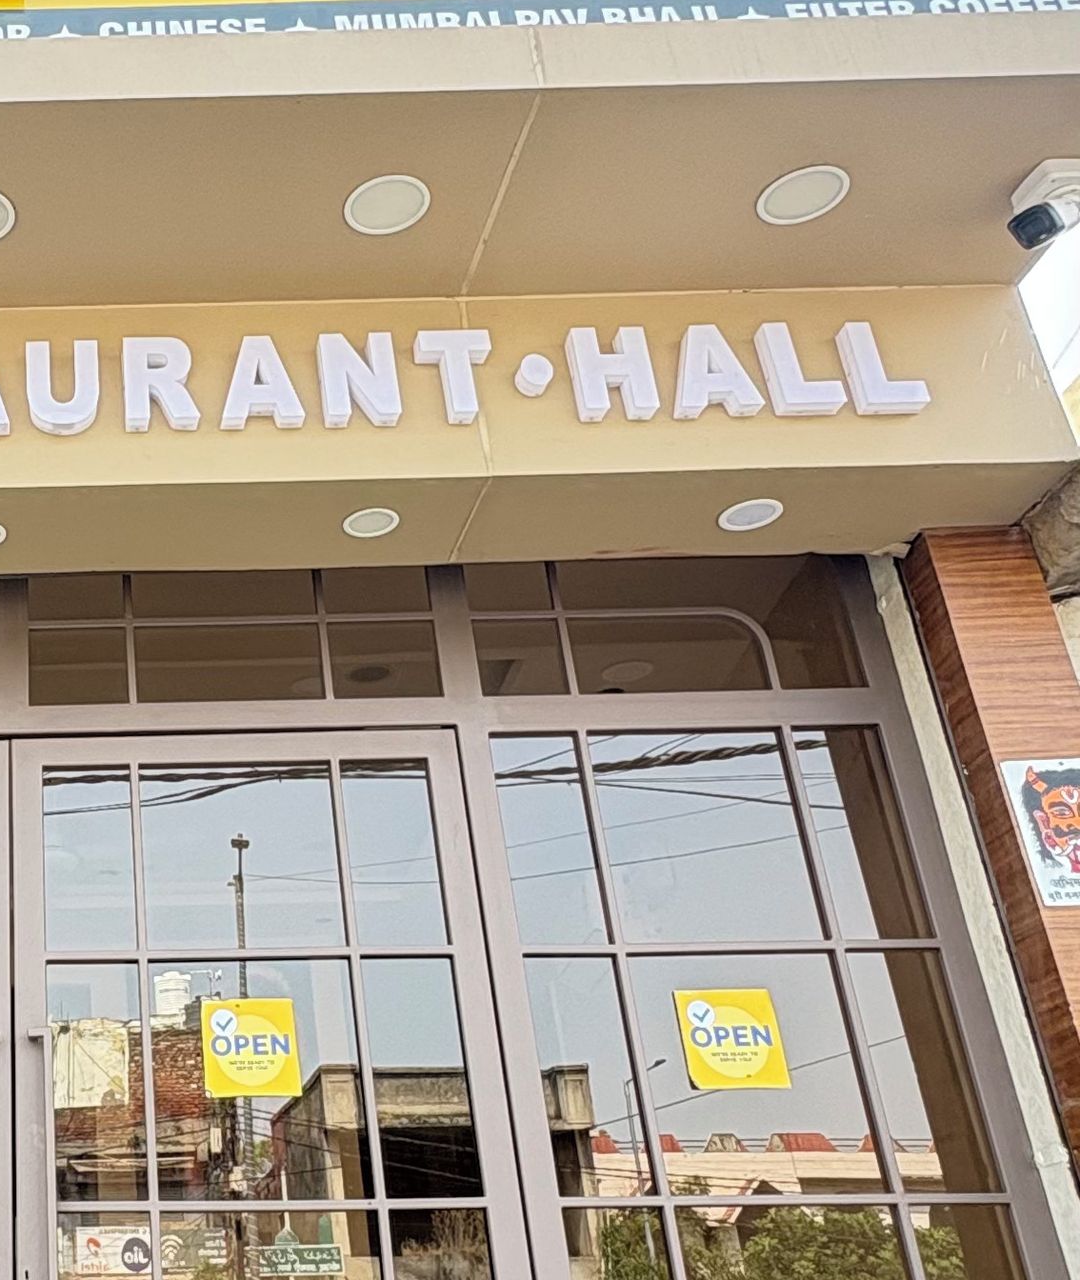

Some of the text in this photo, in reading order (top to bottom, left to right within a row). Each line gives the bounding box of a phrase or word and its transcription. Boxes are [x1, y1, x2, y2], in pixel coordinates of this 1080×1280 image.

[564, 320, 933, 424] HALL
[211, 1033, 290, 1056] OPEN
[690, 1025, 773, 1048] OPEN
